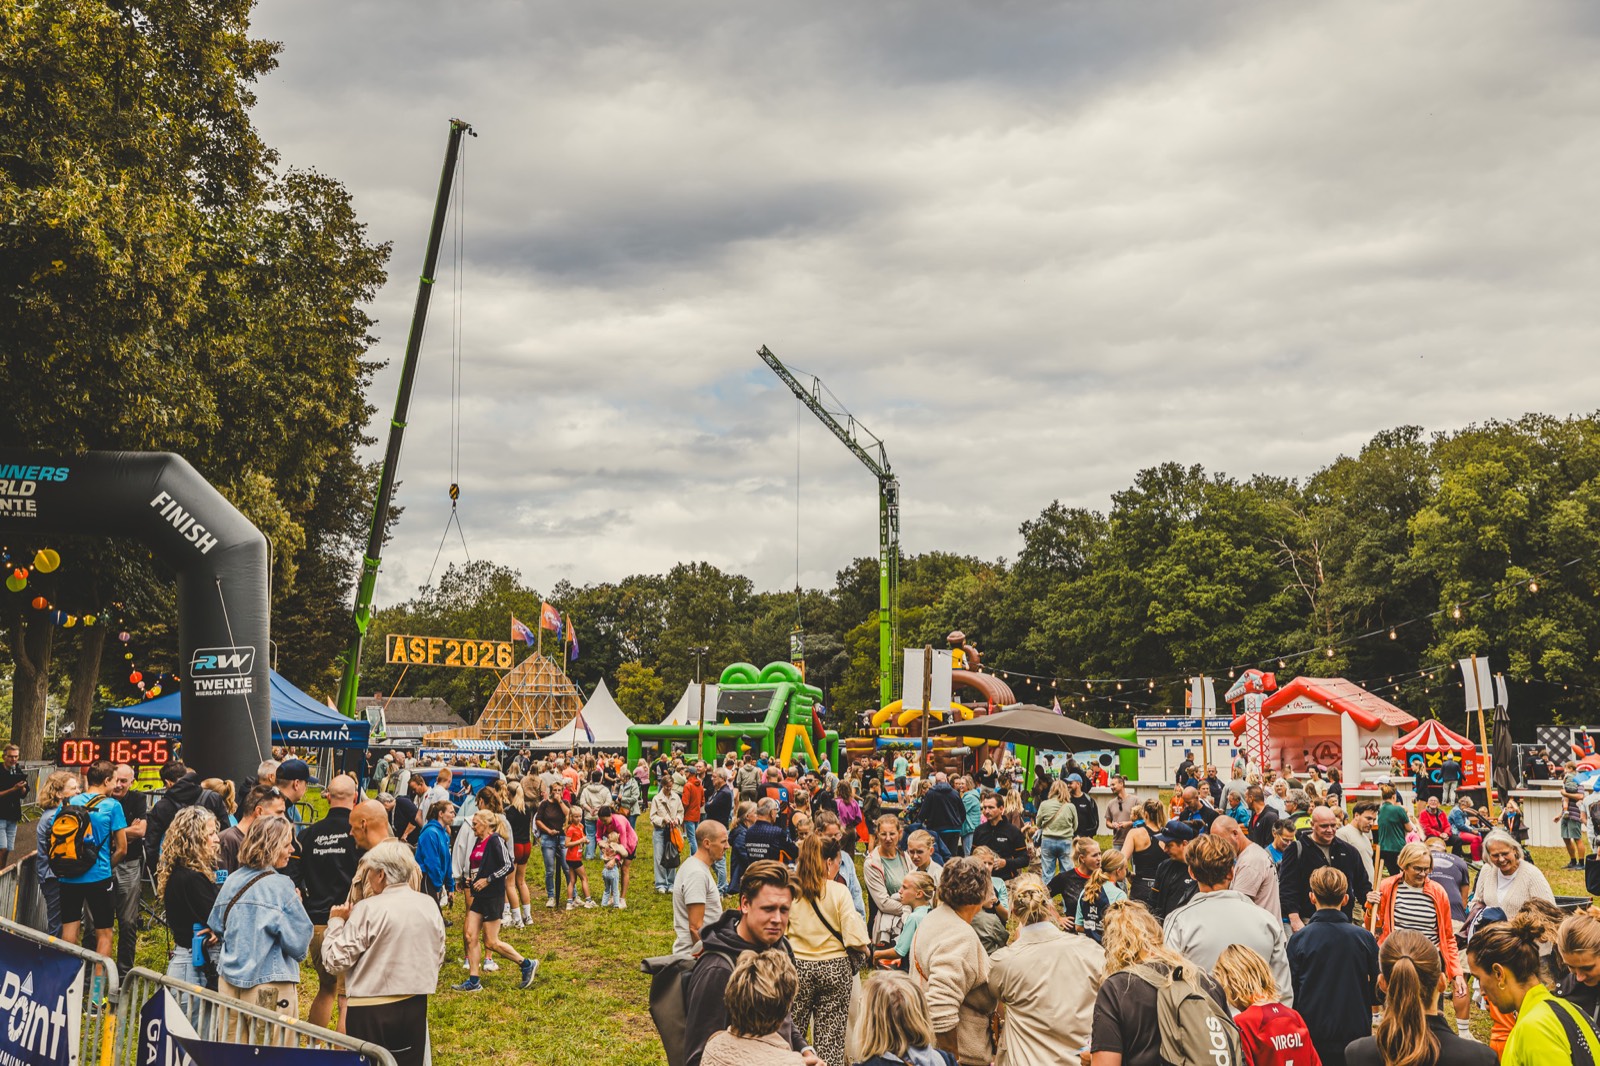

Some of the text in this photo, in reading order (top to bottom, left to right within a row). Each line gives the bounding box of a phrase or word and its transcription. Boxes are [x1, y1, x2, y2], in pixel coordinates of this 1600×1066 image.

[150, 490, 218, 555] FINISH
[392, 636, 512, 668] ASF2026
[194, 653, 251, 670] RW
[193, 677, 252, 691] TWENTE
[120, 715, 182, 732] WayPoin
[287, 730, 351, 741] GARMIN
[0, 968, 66, 1061] Point
[1270, 1032, 1303, 1051] VIRGIL
